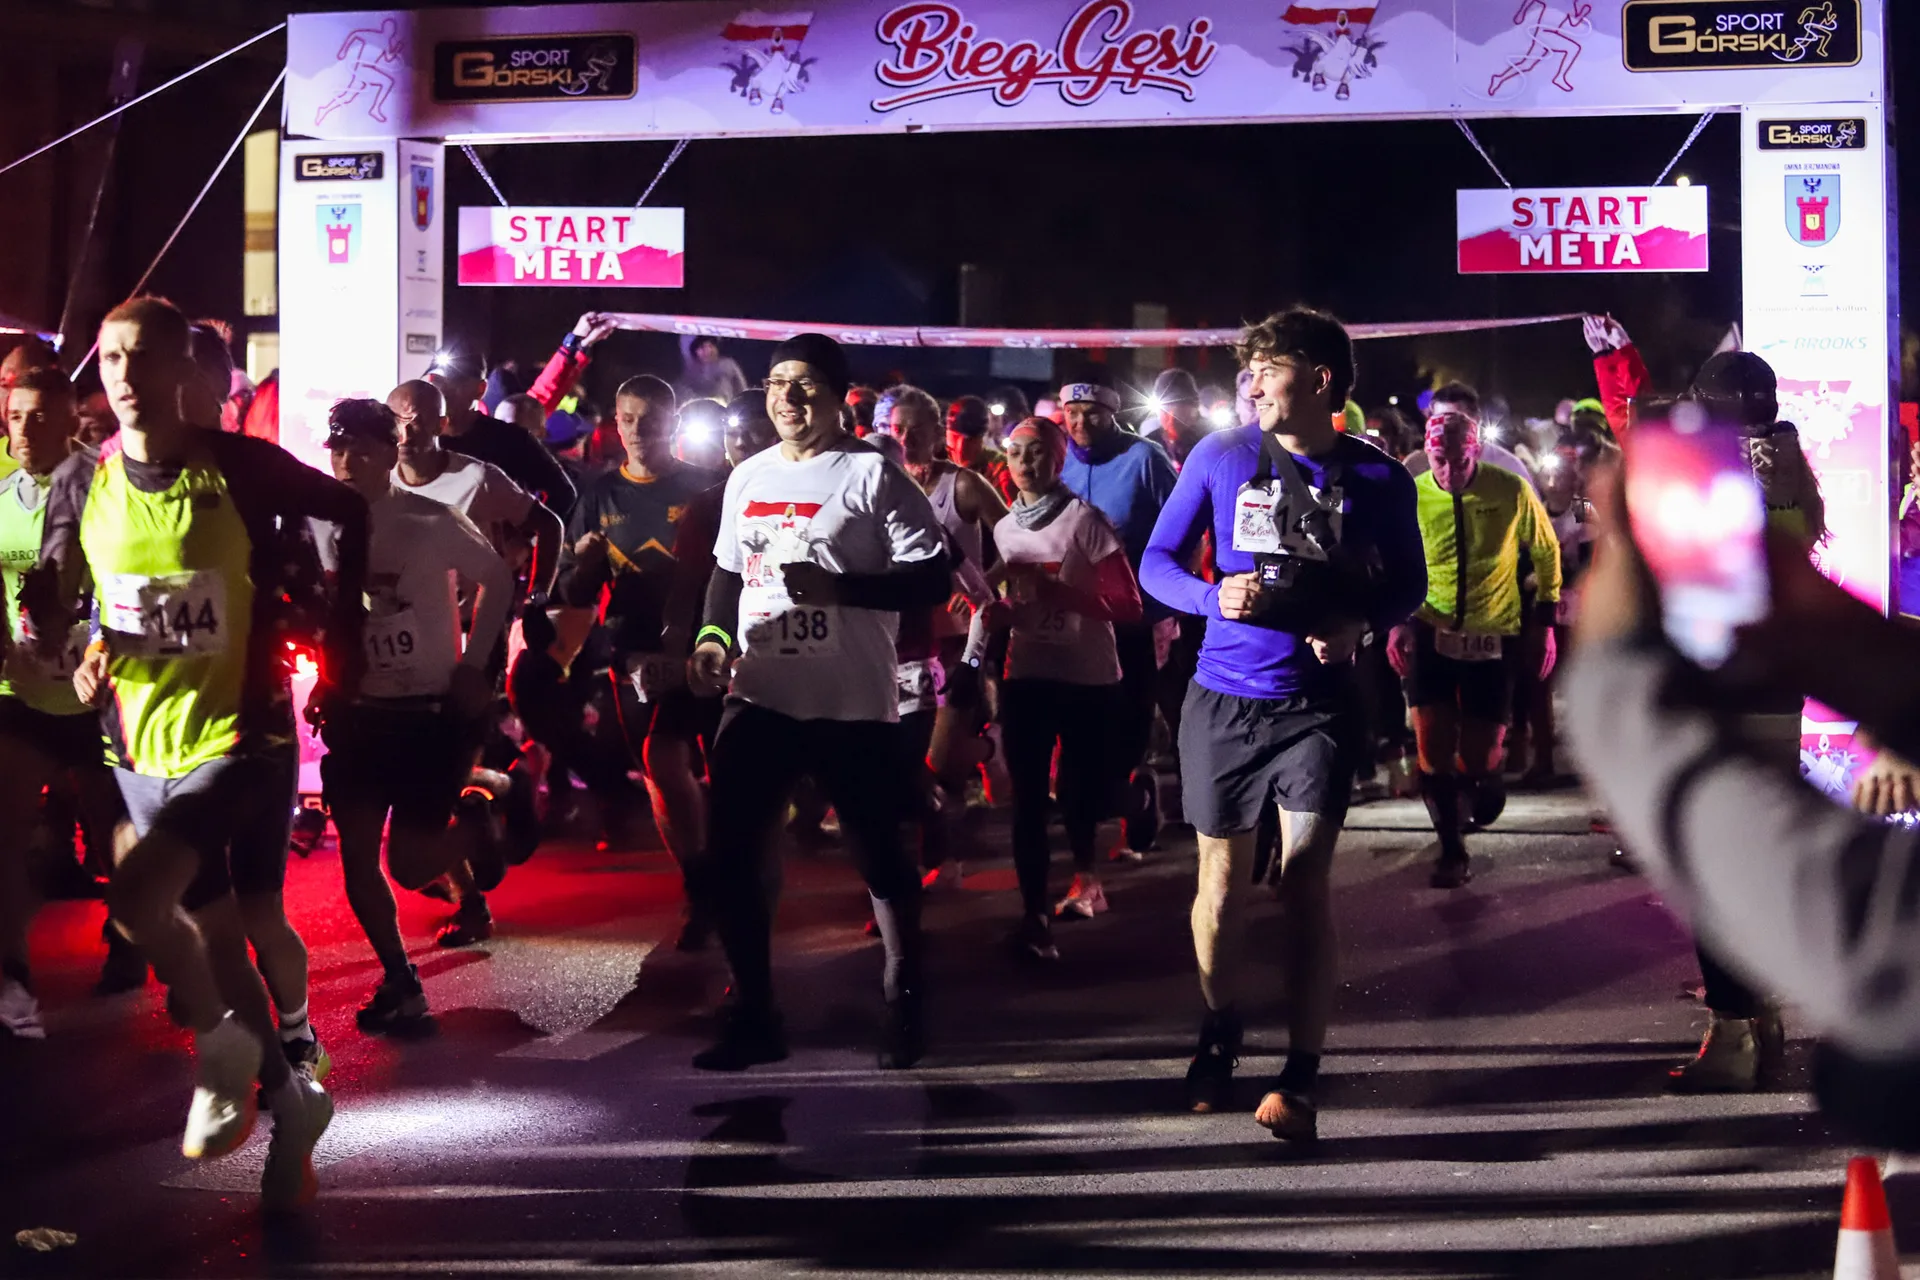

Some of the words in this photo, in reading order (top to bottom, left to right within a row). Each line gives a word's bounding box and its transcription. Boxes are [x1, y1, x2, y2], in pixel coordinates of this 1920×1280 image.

[1649, 14, 1787, 55] GÓRSKI
[1715, 12, 1784, 33] SPORT
[510, 48, 571, 69] SPORT
[876, 2, 1050, 104] Bieg
[452, 51, 573, 89] GÓRSKI
[1768, 124, 1833, 144] GÓRSKI
[1799, 123, 1832, 135] SPORT
[328, 158, 356, 169] SPORT
[1512, 196, 1649, 228] START
[510, 215, 631, 244] START
[1519, 233, 1642, 266] META
[514, 250, 624, 280] META
[1793, 335, 1867, 351] BROOKS
[149, 598, 217, 638] 144
[776, 610, 827, 641] 138
[1038, 608, 1066, 632] 25
[369, 630, 414, 657] 119
